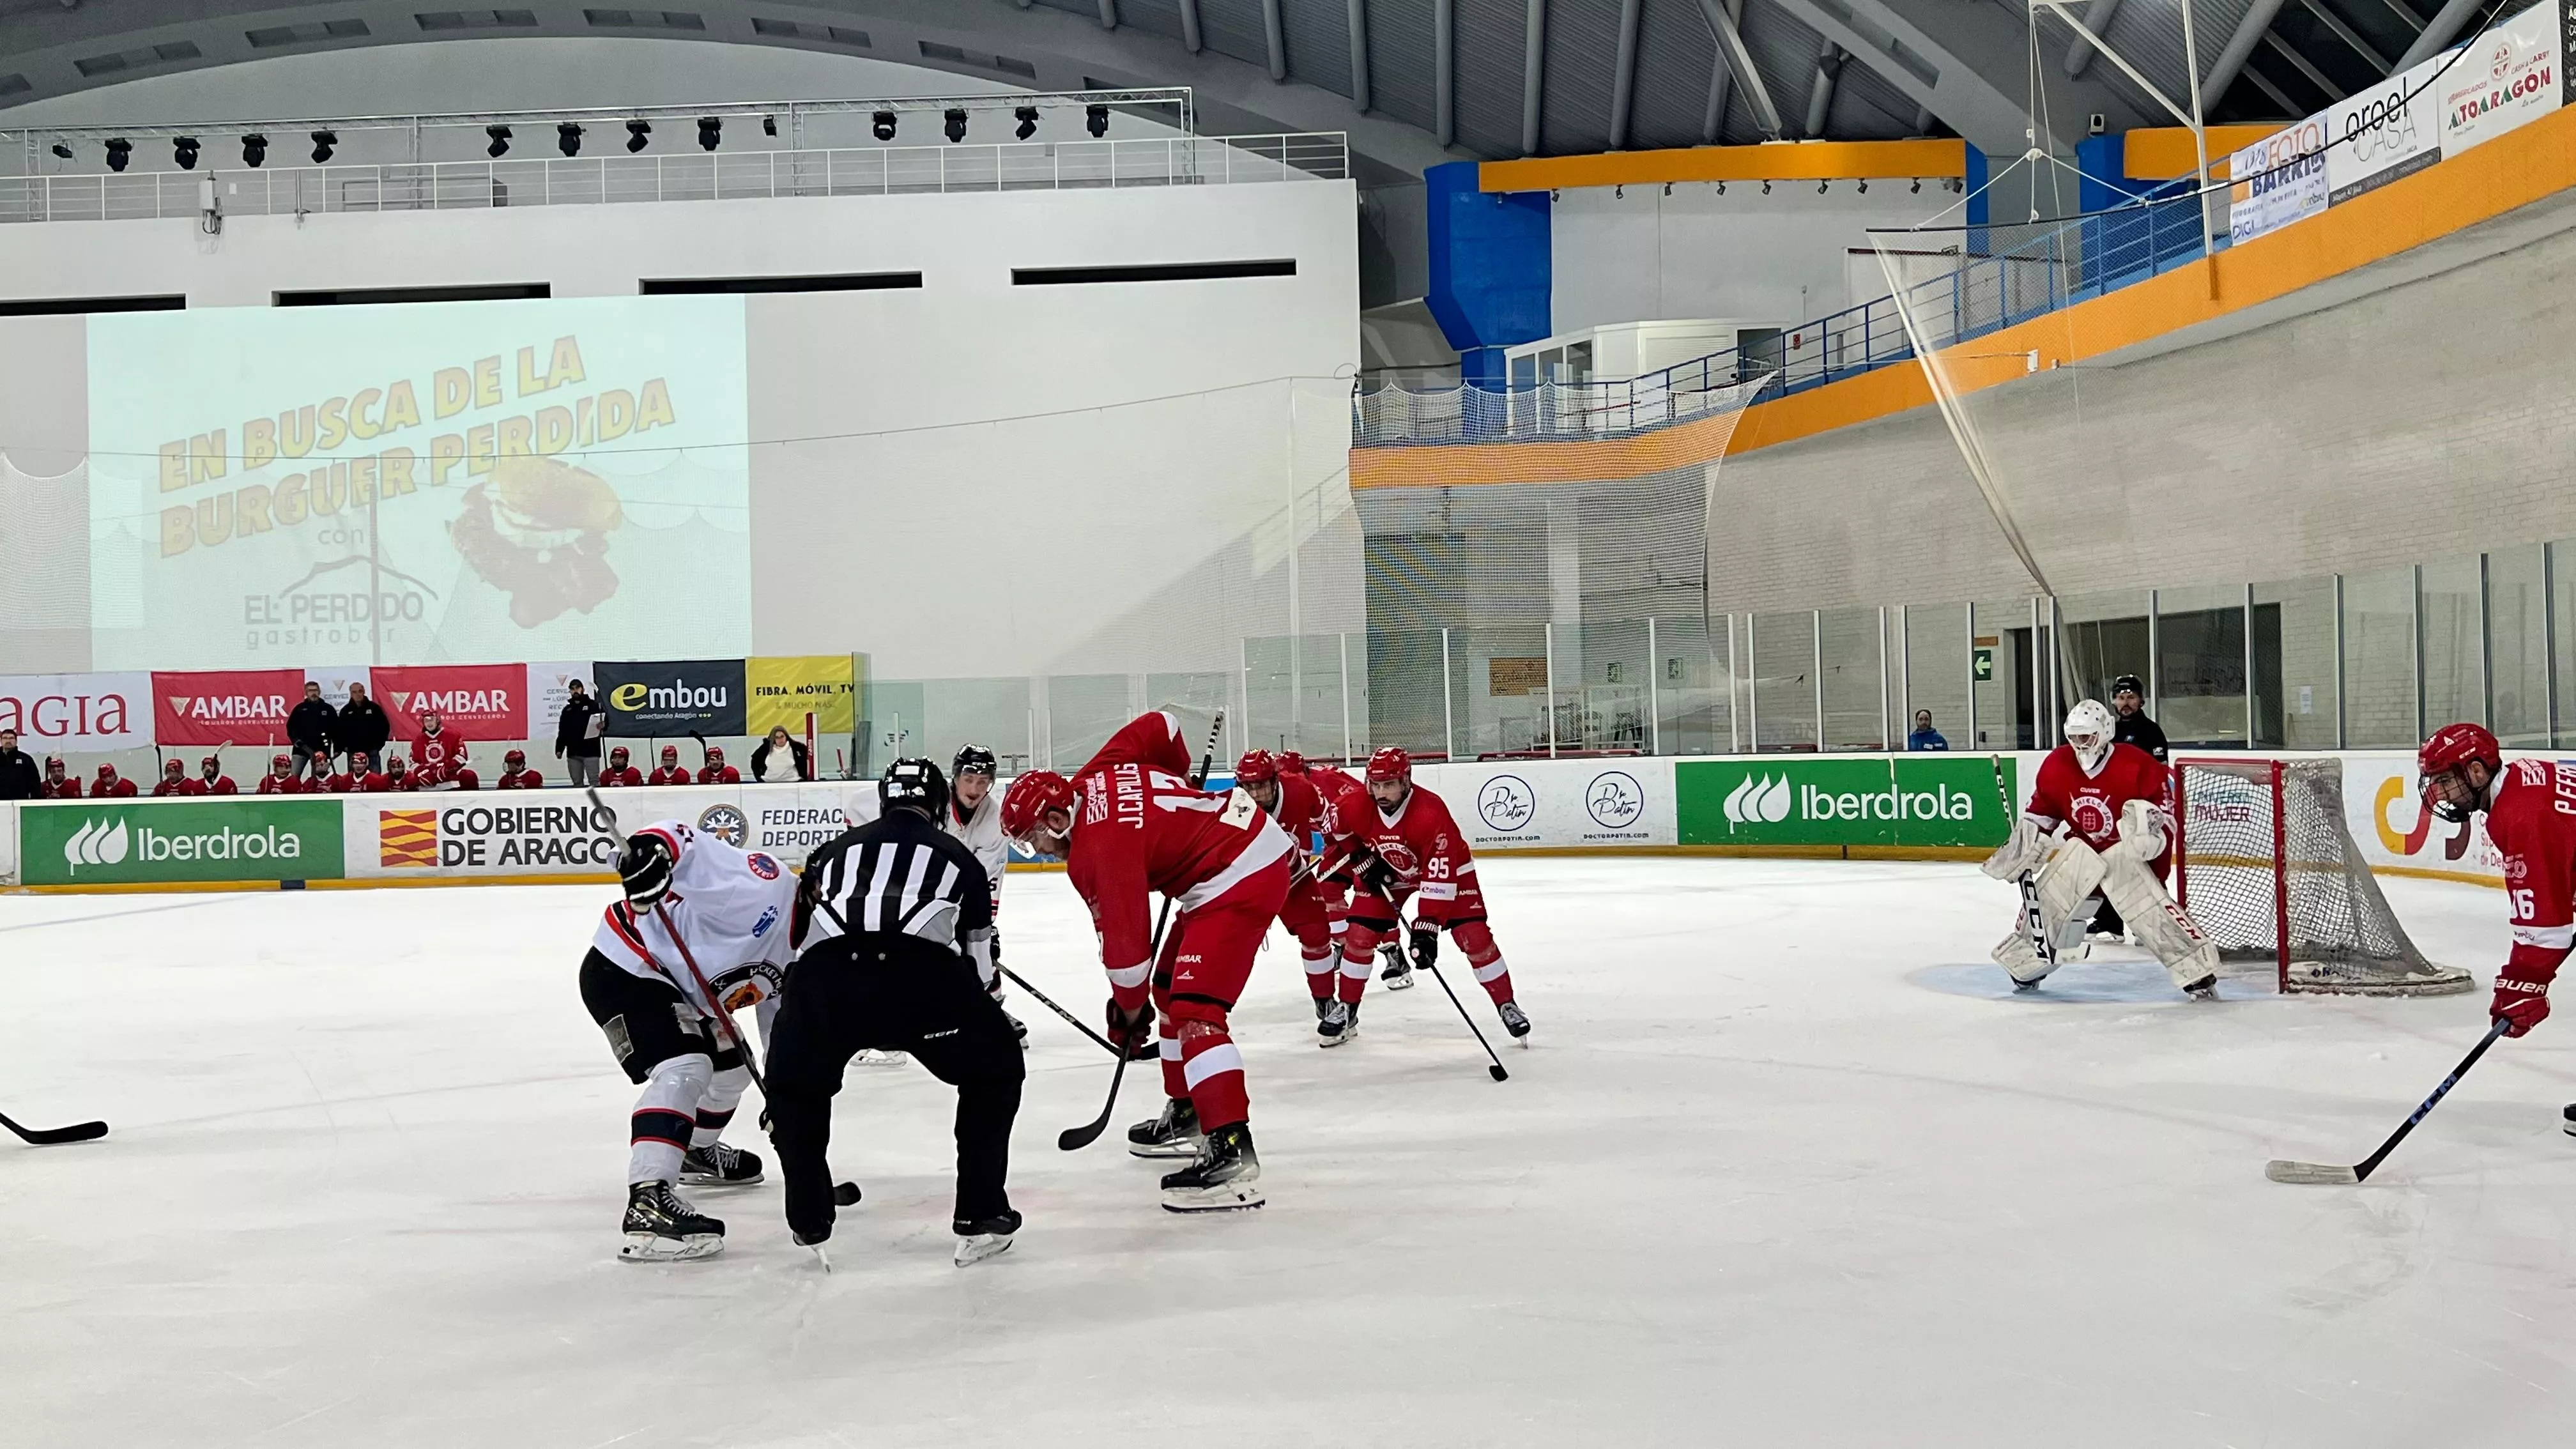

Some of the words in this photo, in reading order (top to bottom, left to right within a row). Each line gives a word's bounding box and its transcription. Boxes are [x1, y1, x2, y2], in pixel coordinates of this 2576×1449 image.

[2345, 76, 2407, 142] oroel
[159, 427, 227, 494] EN
[242, 378, 422, 471] BUSCA
[433, 354, 503, 420] DE
[517, 334, 587, 398] LA
[160, 446, 418, 558] BURGUER
[430, 377, 676, 487] PERDIDA
[318, 528, 364, 545] con
[290, 591, 424, 624] PERDDO
[410, 689, 511, 714] AMBAR
[610, 678, 727, 712] embou
[839, 683, 855, 694] TV
[191, 695, 290, 719] AMBAR
[1113, 762, 1144, 829] J.CAPILLAS
[1800, 783, 1973, 820] Iberdrola
[2076, 797, 2103, 808] HIELO
[441, 806, 617, 836] GOBIERNO
[137, 825, 300, 862] Iberdrola
[442, 839, 486, 867] DE
[1427, 857, 1450, 879] 95
[1421, 885, 1446, 894] embou
[2023, 880, 2050, 958] CCM
[2165, 905, 2202, 940] CCM
[923, 1028, 959, 1039] CCM
[627, 1208, 652, 1228] CCM
